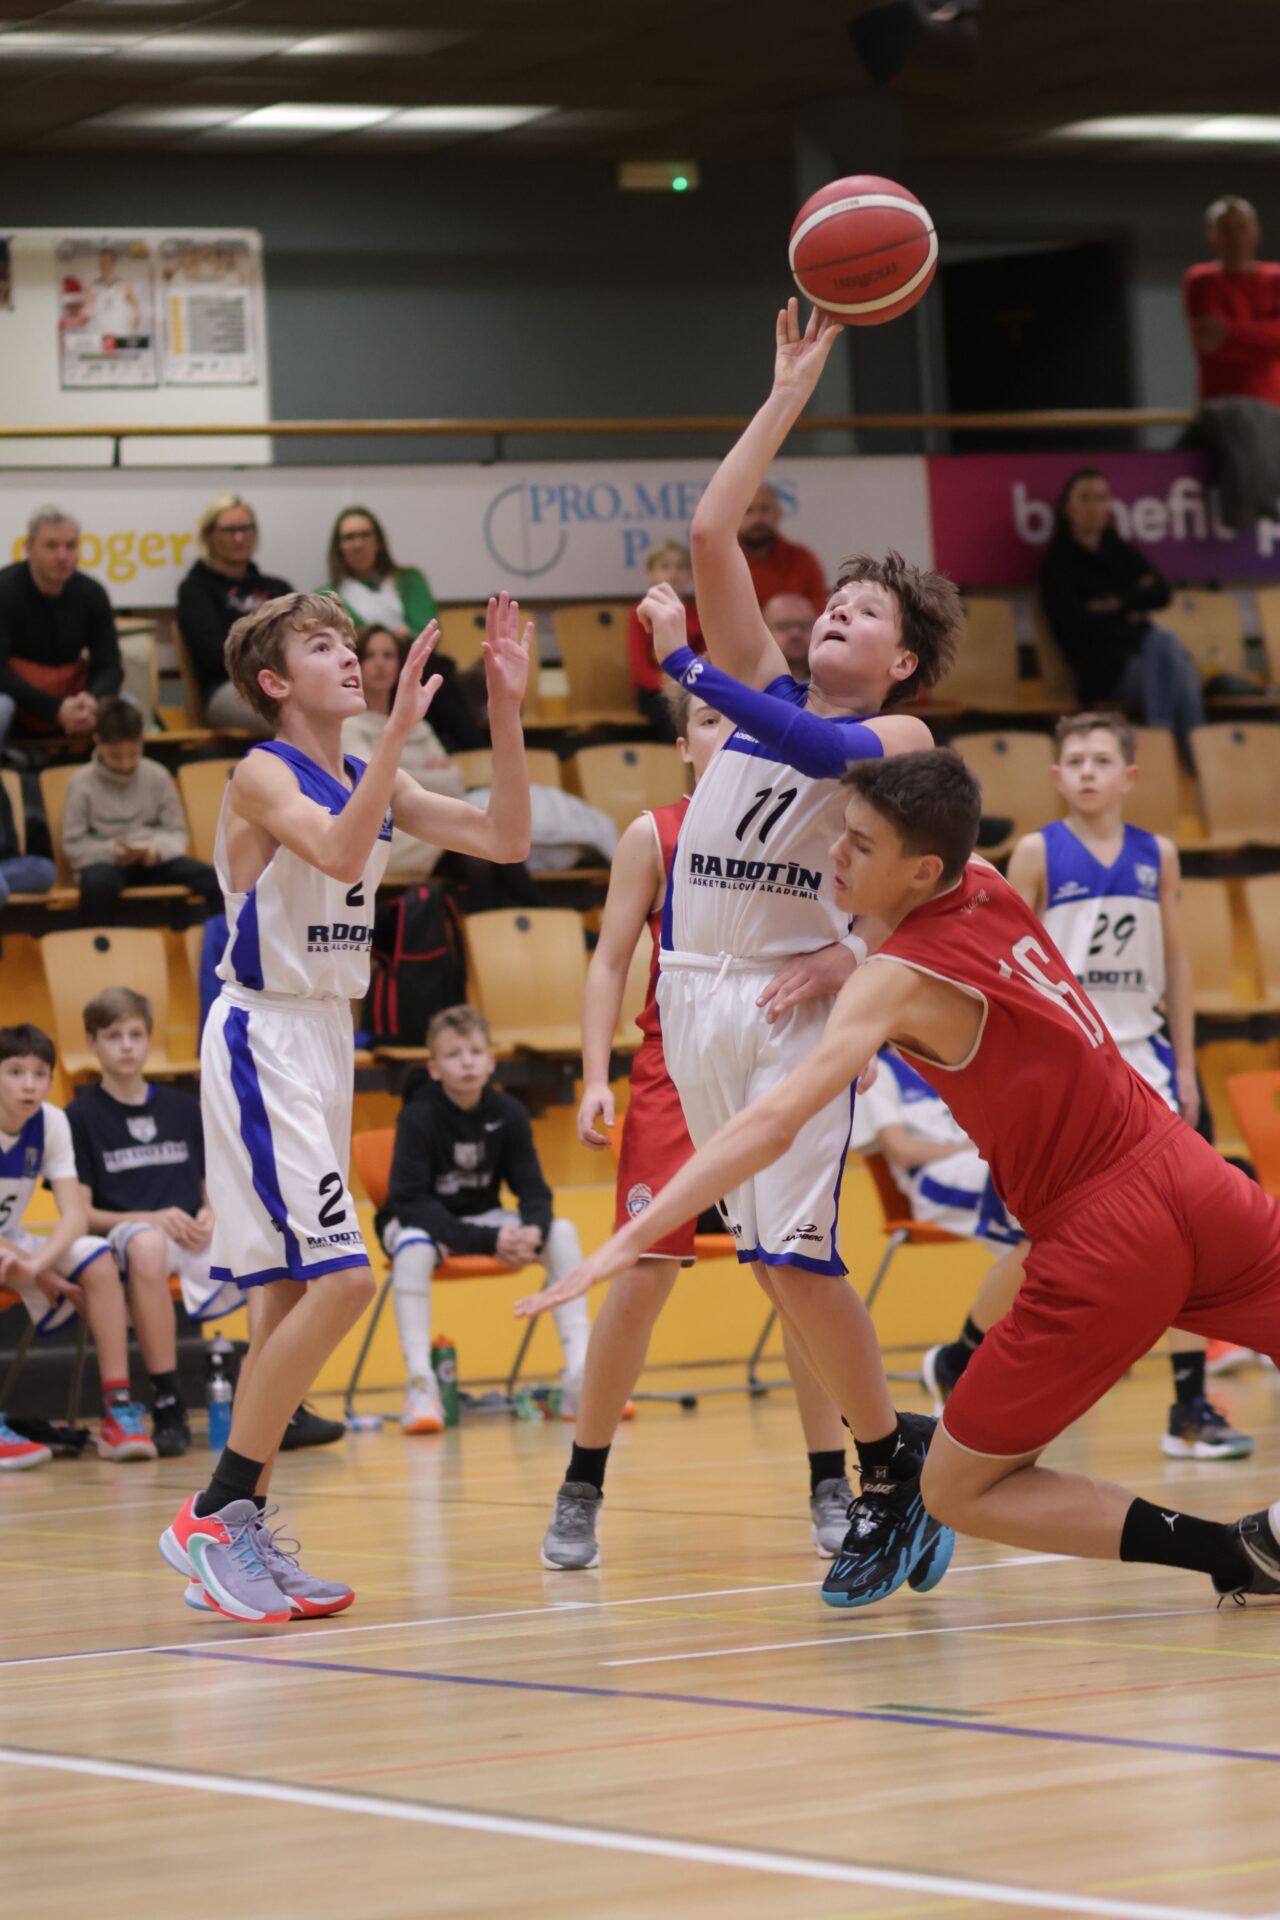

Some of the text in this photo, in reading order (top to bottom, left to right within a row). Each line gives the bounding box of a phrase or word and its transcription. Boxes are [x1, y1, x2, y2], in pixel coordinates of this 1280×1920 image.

[1011, 477, 1236, 545] bnefit
[735, 787, 798, 844] 11
[1088, 912, 1136, 957] 29
[318, 1171, 346, 1228] 2
